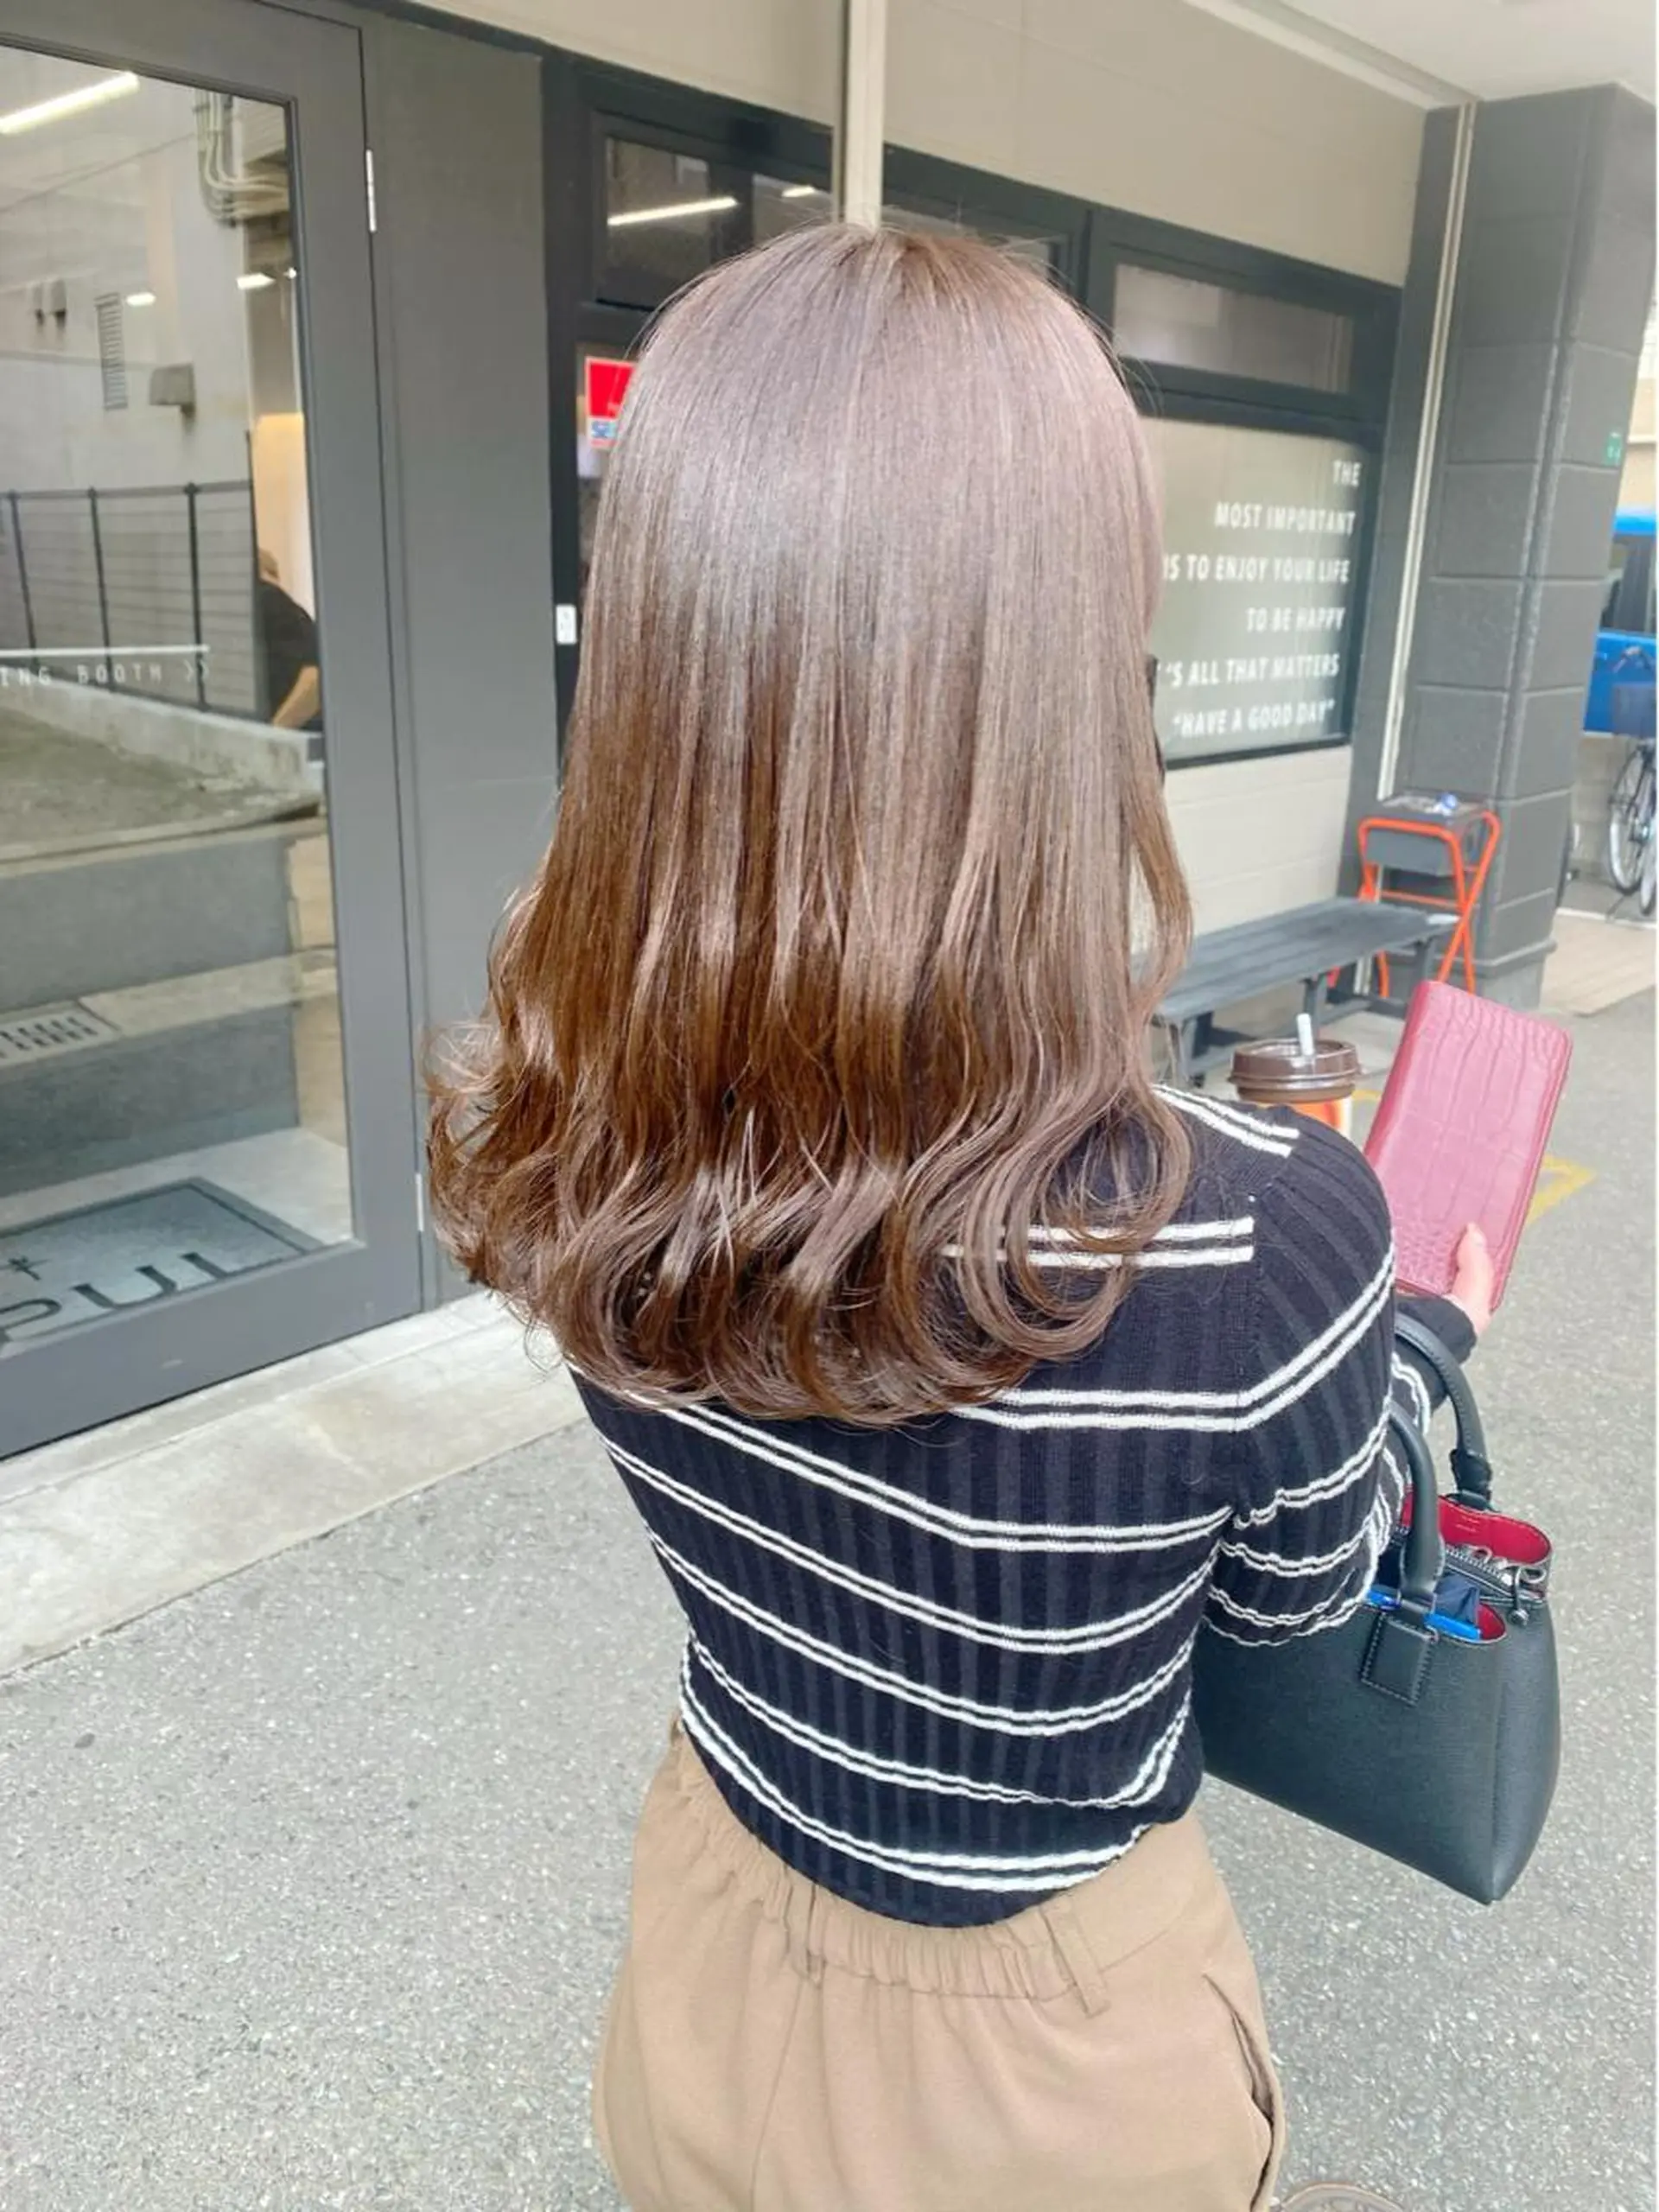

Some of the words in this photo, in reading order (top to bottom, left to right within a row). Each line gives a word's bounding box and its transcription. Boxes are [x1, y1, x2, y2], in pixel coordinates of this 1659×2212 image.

[1333, 460, 1362, 487] THE
[1214, 501, 1262, 529] MOST
[1266, 505, 1356, 536] IMPORTANT
[1186, 554, 1210, 581] TO
[1215, 555, 1268, 582] ENJOY
[1274, 556, 1316, 582] YOUR
[1318, 559, 1351, 584] LIFE
[1246, 607, 1268, 632] TO
[1271, 607, 1292, 632] BE
[1296, 607, 1345, 632] HAPPY
[1187, 661, 1221, 685] ALL
[1225, 658, 1270, 683] THAT
[1272, 654, 1339, 680] MATTERS
[1231, 708, 1243, 733] A
[1248, 702, 1293, 731] GOOD
